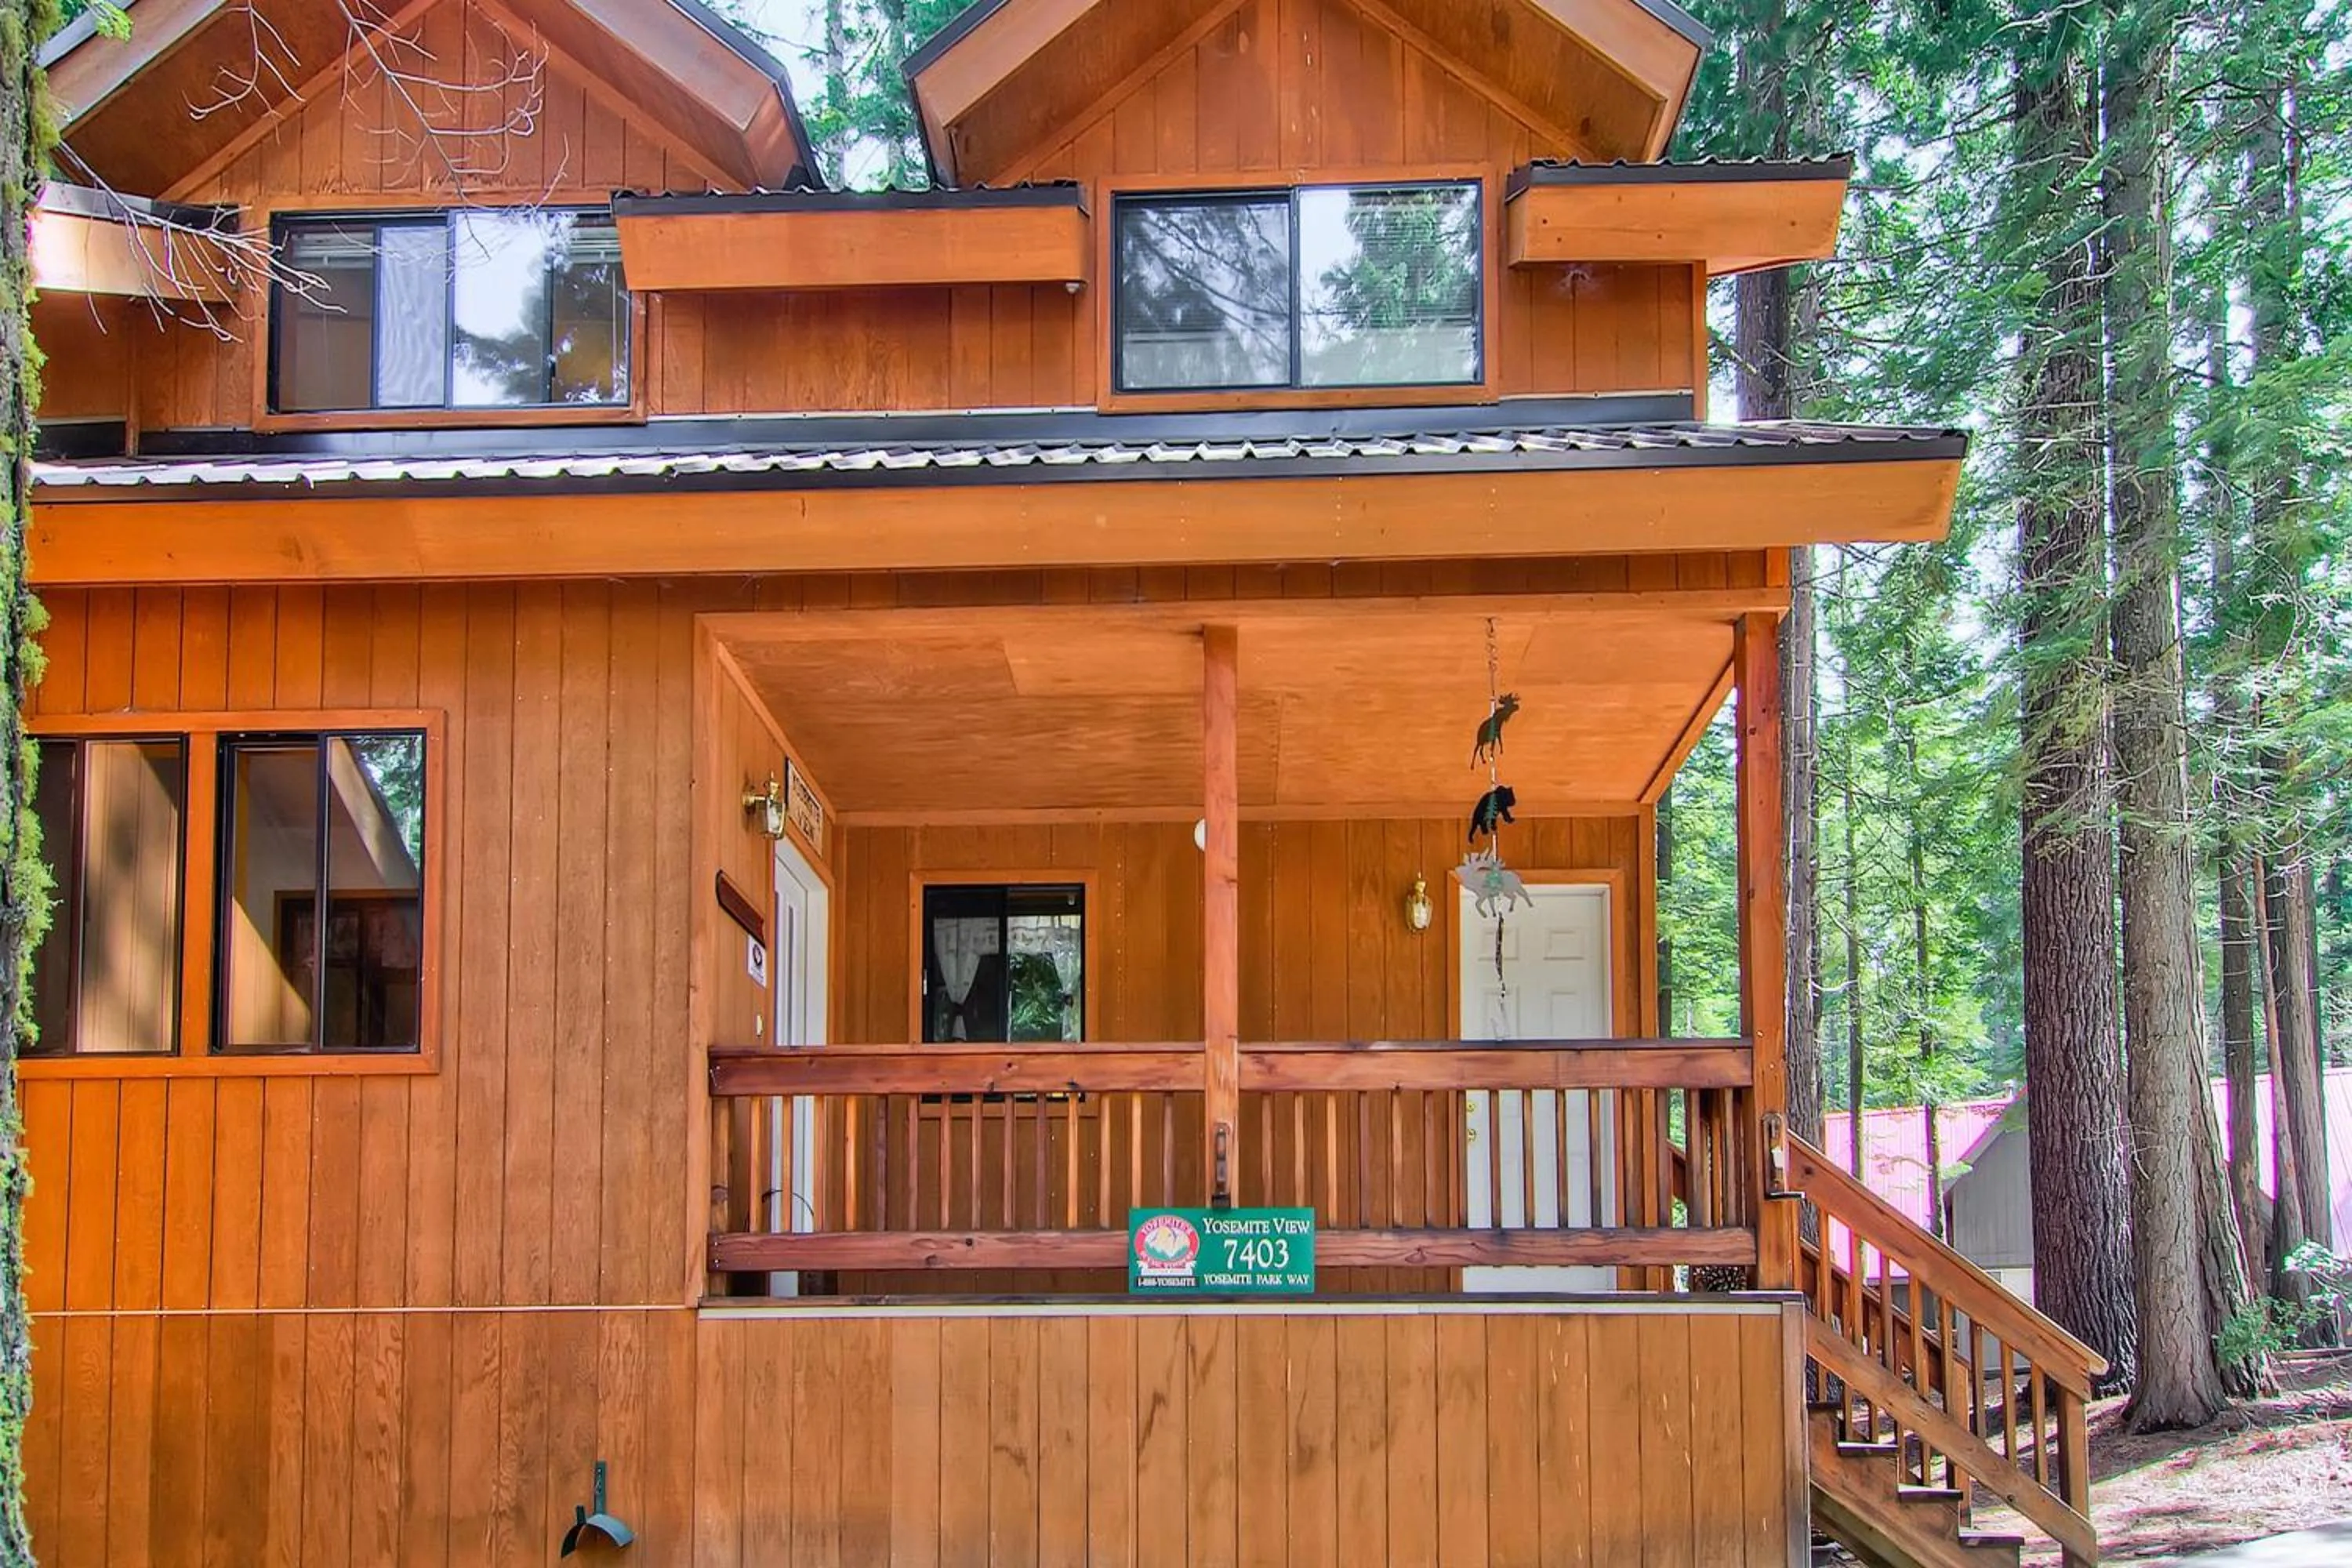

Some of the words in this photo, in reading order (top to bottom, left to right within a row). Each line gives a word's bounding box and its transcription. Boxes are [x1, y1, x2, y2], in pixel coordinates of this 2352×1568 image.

[1202, 1218, 1270, 1234] YOSEMITE
[1272, 1218, 1310, 1234] VIEW
[1224, 1238, 1290, 1270] 7403
[1203, 1274, 1253, 1285] YOSEMITE
[1257, 1274, 1282, 1285] PARK
[1287, 1274, 1310, 1284] WAY
